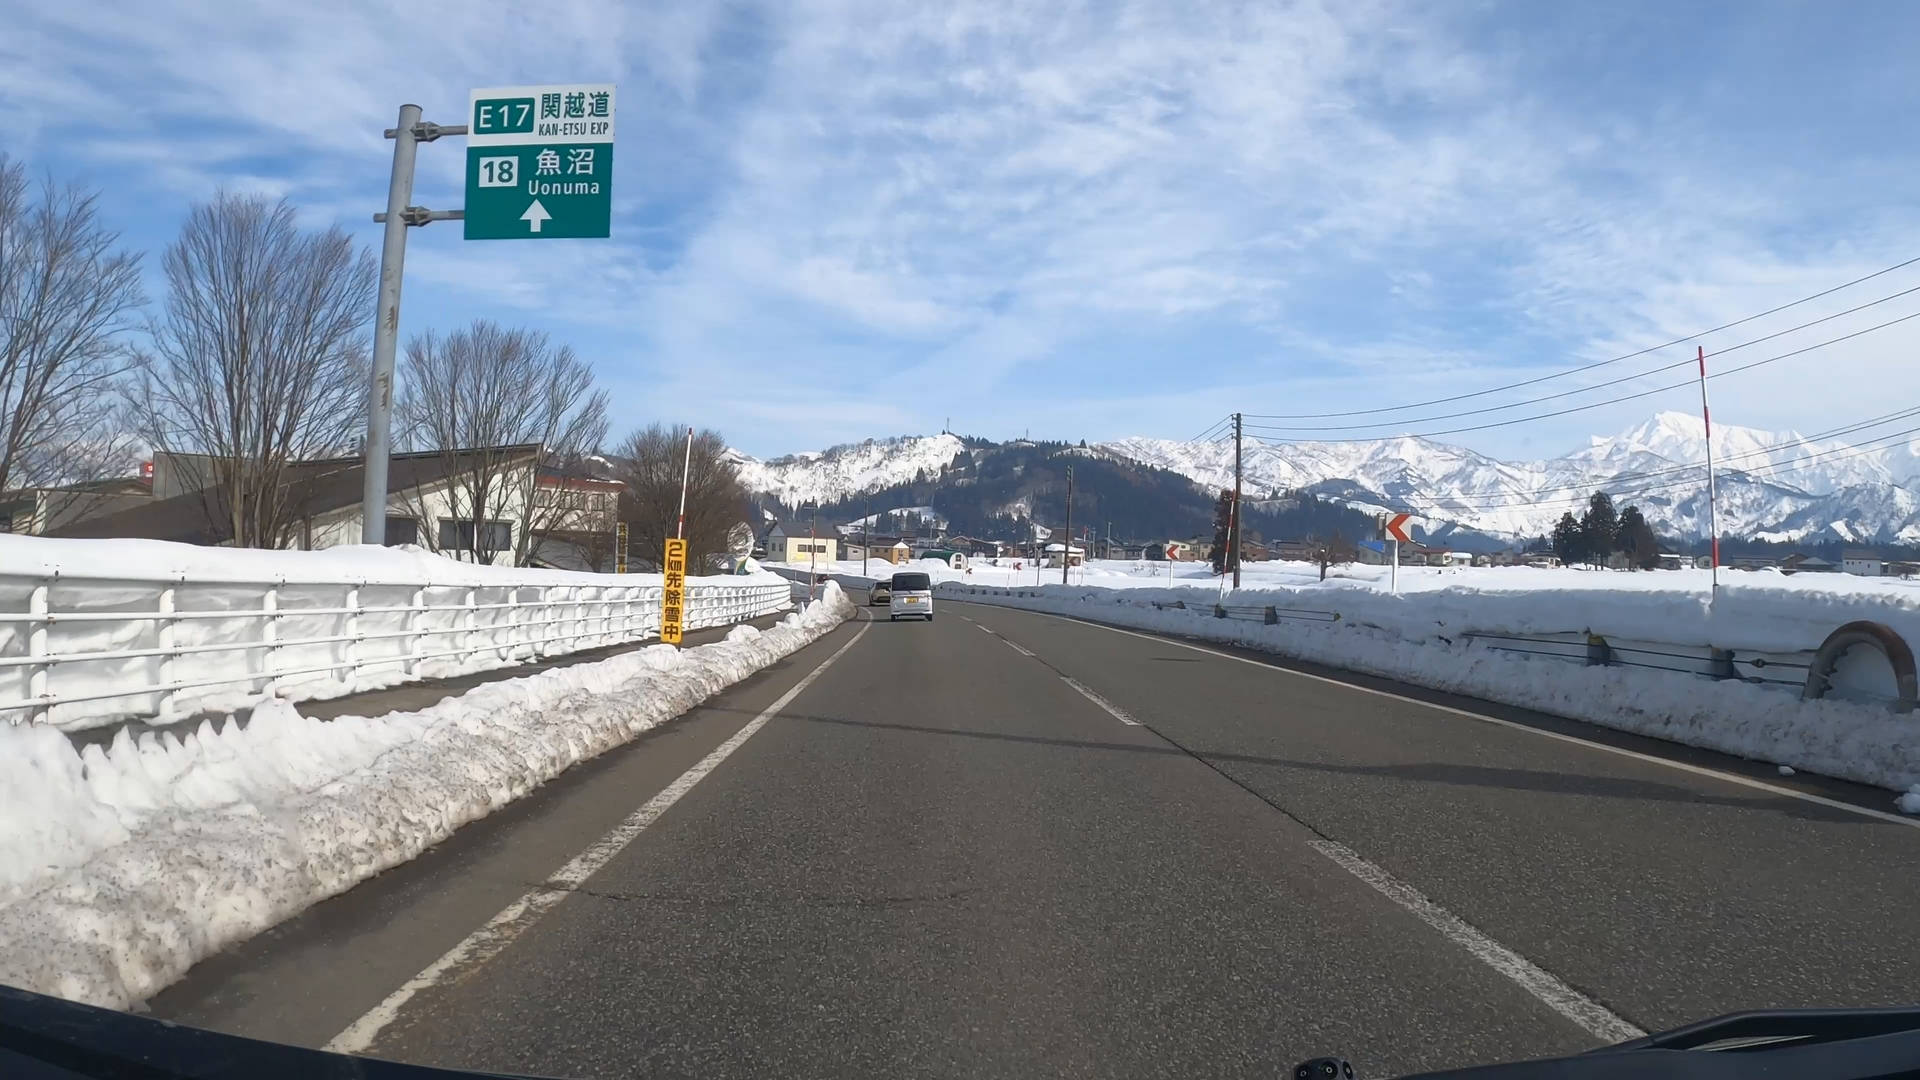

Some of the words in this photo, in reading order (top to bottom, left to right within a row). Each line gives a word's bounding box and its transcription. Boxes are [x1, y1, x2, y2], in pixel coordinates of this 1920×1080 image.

[479, 104, 530, 128] E17
[540, 91, 610, 120] 関越道
[538, 122, 587, 136] KAN-ETSU
[590, 121, 609, 135] EXP
[483, 160, 514, 183] 18
[535, 148, 595, 176] 魚沼
[528, 179, 600, 195] Uonuma
